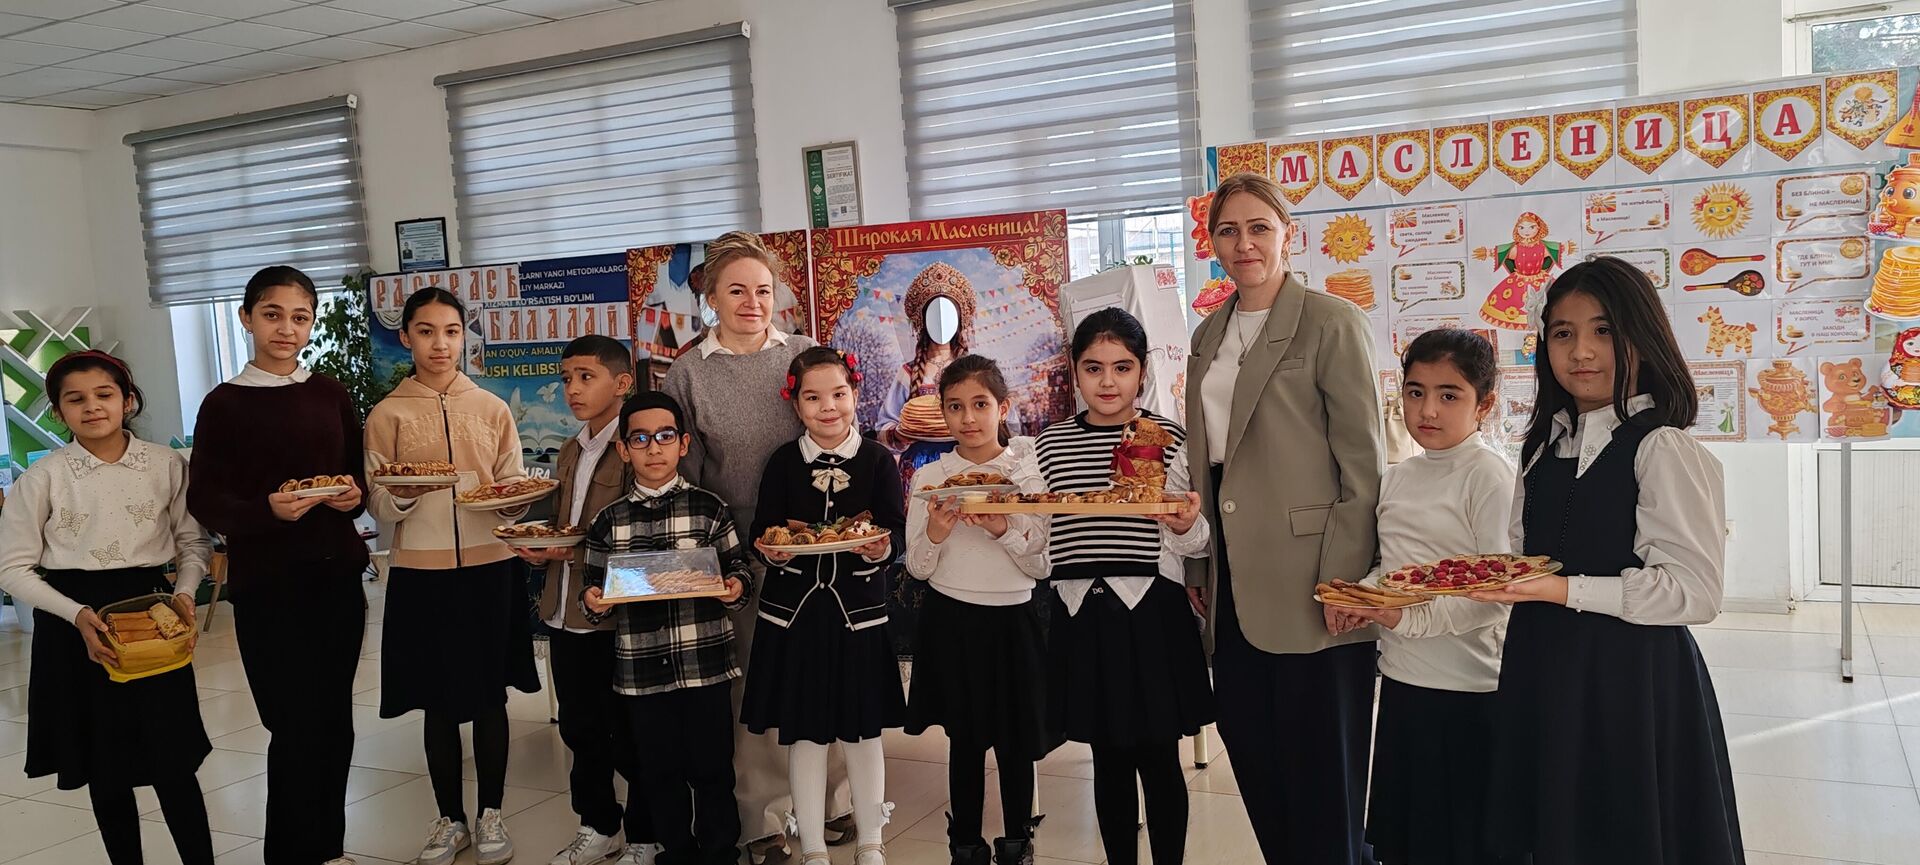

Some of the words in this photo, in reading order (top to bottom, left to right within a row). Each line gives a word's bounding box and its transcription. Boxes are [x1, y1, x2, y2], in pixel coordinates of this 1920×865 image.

[1280, 103, 1802, 184] МАСЛЕНИЦА
[836, 228, 922, 250] Широкая
[926, 213, 1040, 242] Масленица!
[544, 269, 565, 278] YANGI
[567, 264, 628, 277] METODIKALARGA
[533, 281, 565, 291] MARKAZI
[531, 346, 563, 356] AMALIY
[477, 365, 510, 378] USH
[513, 363, 562, 377] KELIBSI
[1092, 587, 1104, 595] DG
